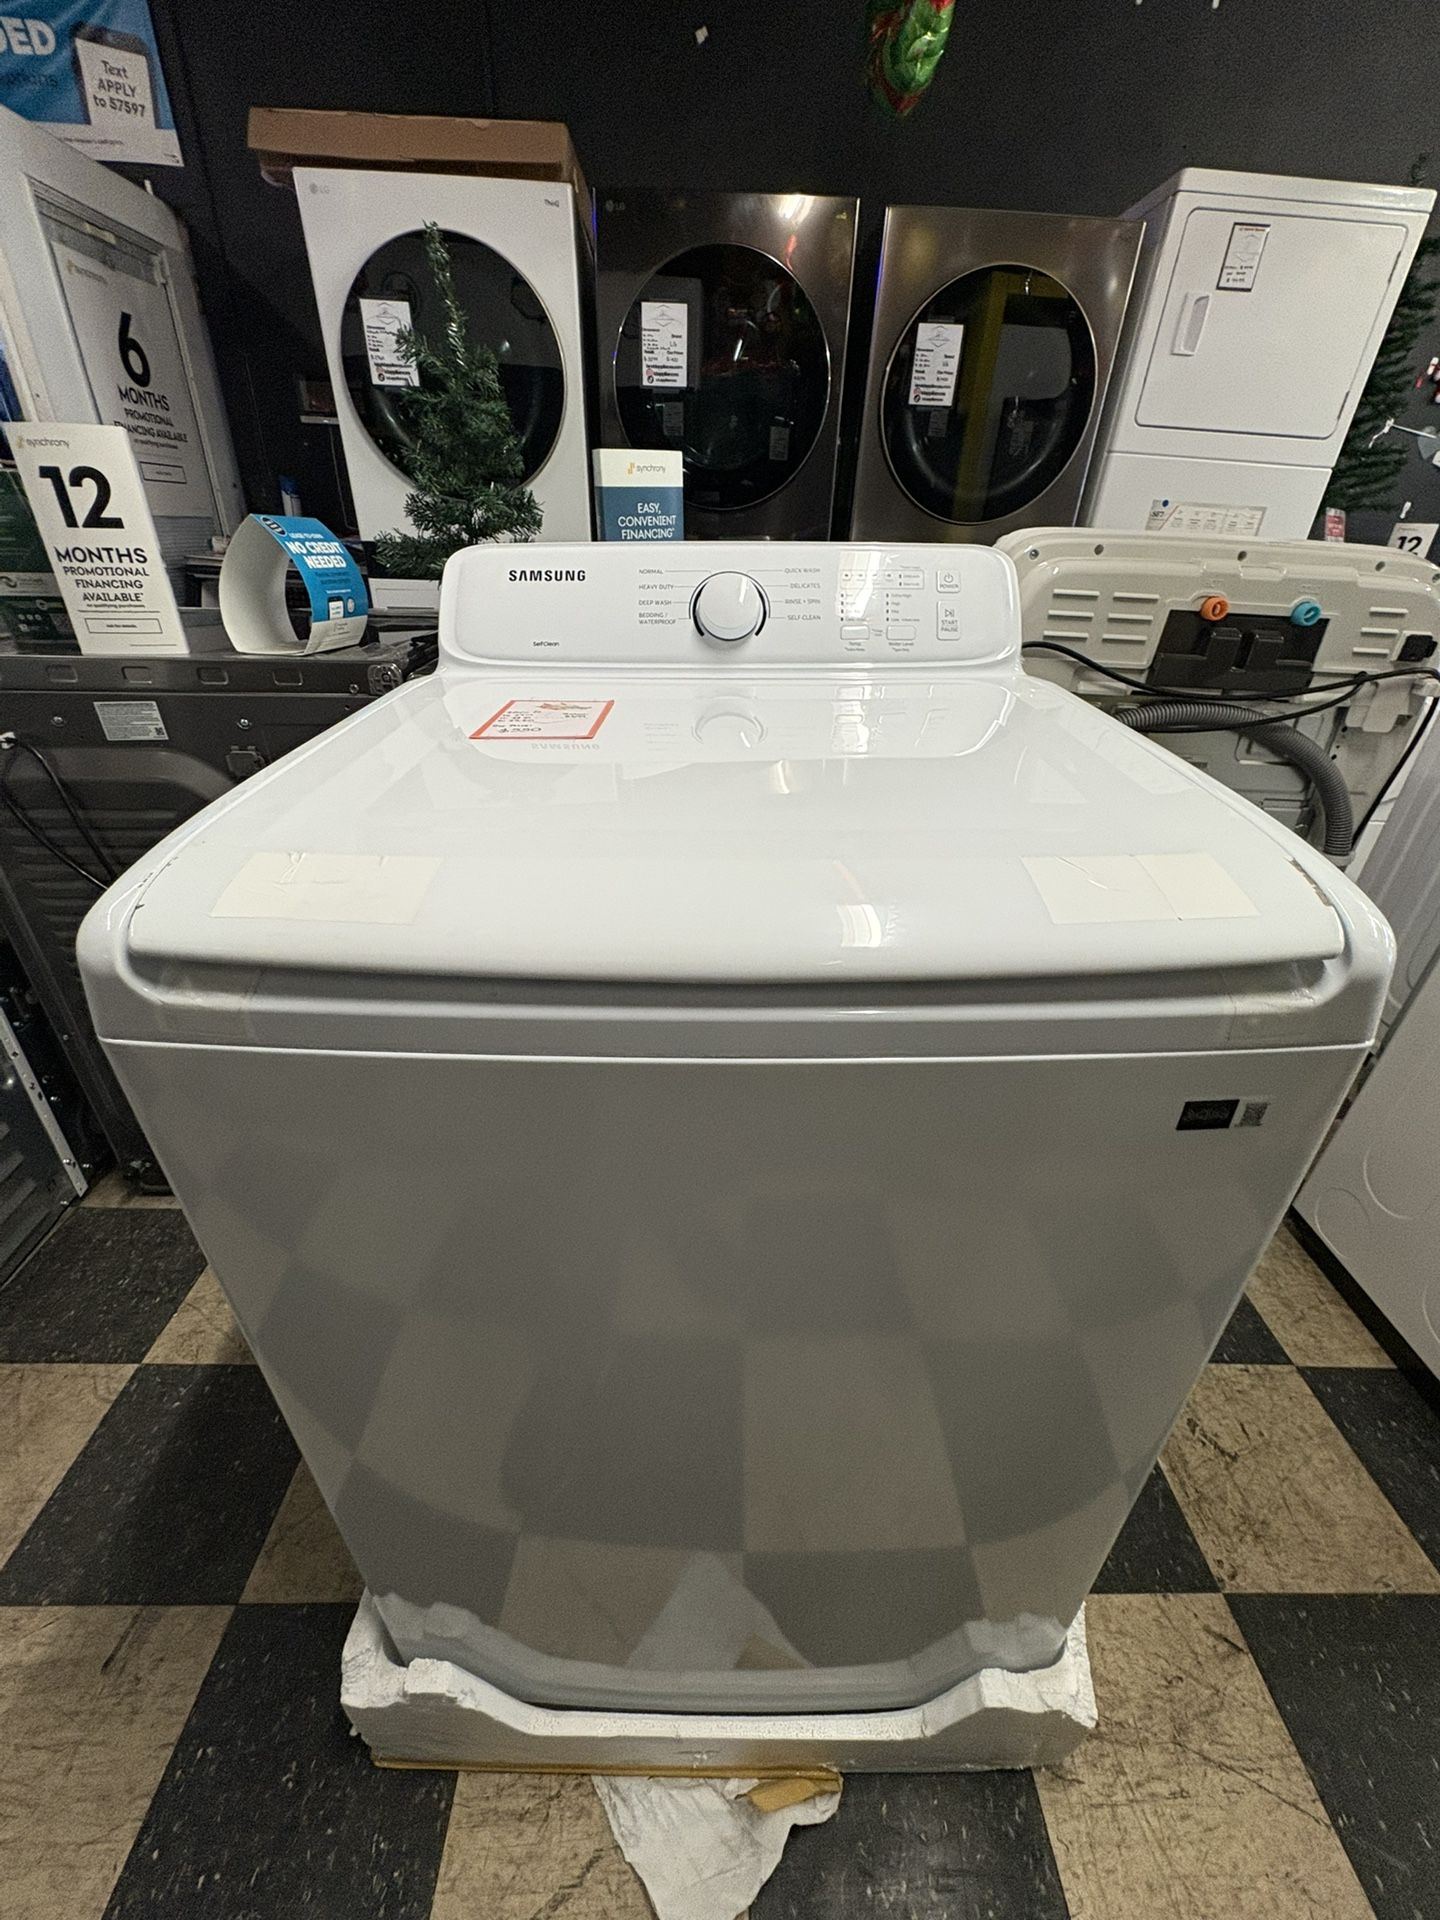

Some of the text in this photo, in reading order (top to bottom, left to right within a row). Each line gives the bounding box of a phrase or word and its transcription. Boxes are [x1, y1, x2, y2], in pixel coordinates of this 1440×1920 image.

[101, 60, 129, 78] Text
[97, 79, 138, 98] APPLY
[93, 94, 146, 118] to 57597
[118, 311, 151, 388] 6
[117, 385, 170, 412] MONTHS
[124, 408, 174, 428] PROMOTIONAL
[26, 437, 70, 449] synchrony
[636, 463, 666, 474] synchrony
[38, 465, 125, 530] 12
[637, 502, 662, 515] EASY,
[617, 515, 677, 527] CONVENIENT
[284, 541, 344, 555] NO CREDIT
[1397, 535, 1423, 556] 12
[54, 546, 149, 564] MONTHS
[303, 555, 347, 569] NEEDED
[63, 565, 150, 577] PROMOTIONAL
[508, 569, 587, 582] SAMSUNG
[75, 578, 144, 590] FINANCING
